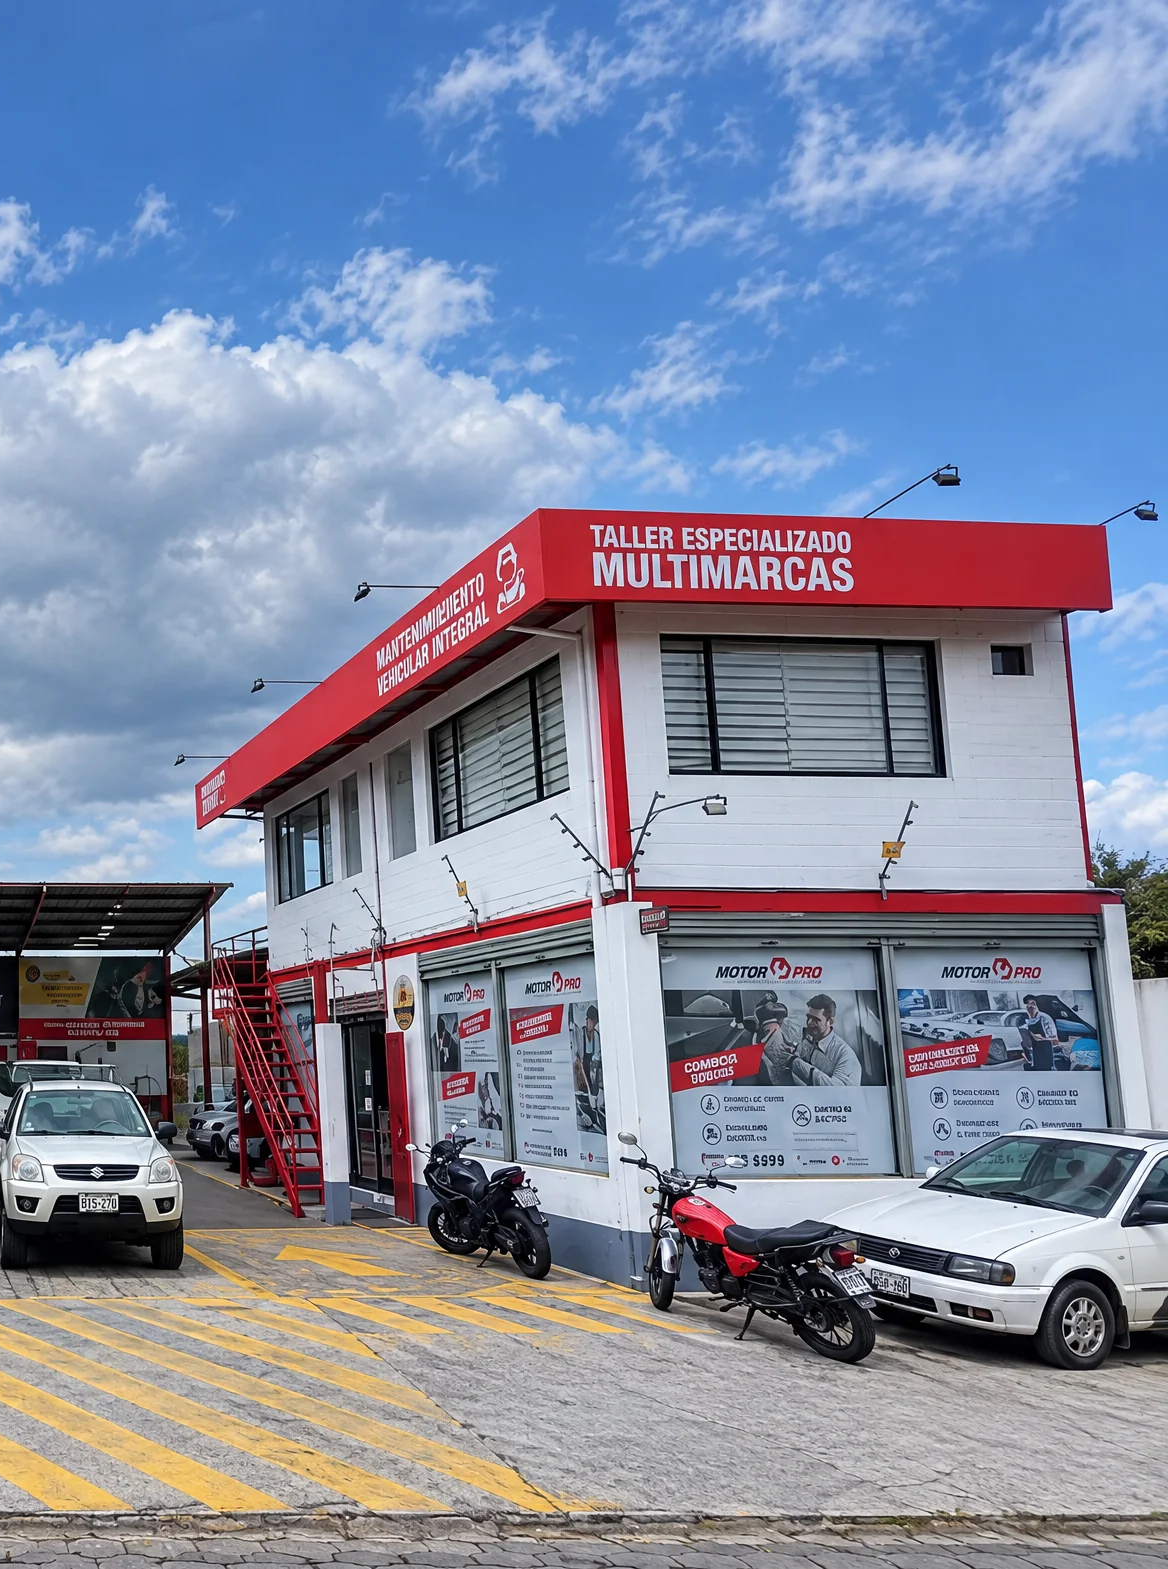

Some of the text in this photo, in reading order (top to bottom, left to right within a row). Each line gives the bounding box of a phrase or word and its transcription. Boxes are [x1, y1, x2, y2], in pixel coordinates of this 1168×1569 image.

[589, 525, 852, 554] TALLER ESPECIALIZADO
[592, 552, 854, 592] MULTIMARCAS
[377, 601, 489, 697] VEHICULAR INTEGRAL
[716, 965, 823, 979] MOTOR PRO
[941, 966, 1042, 979] MOTOR PRO
[524, 980, 551, 995] MOTOR
[564, 977, 581, 991] PRO
